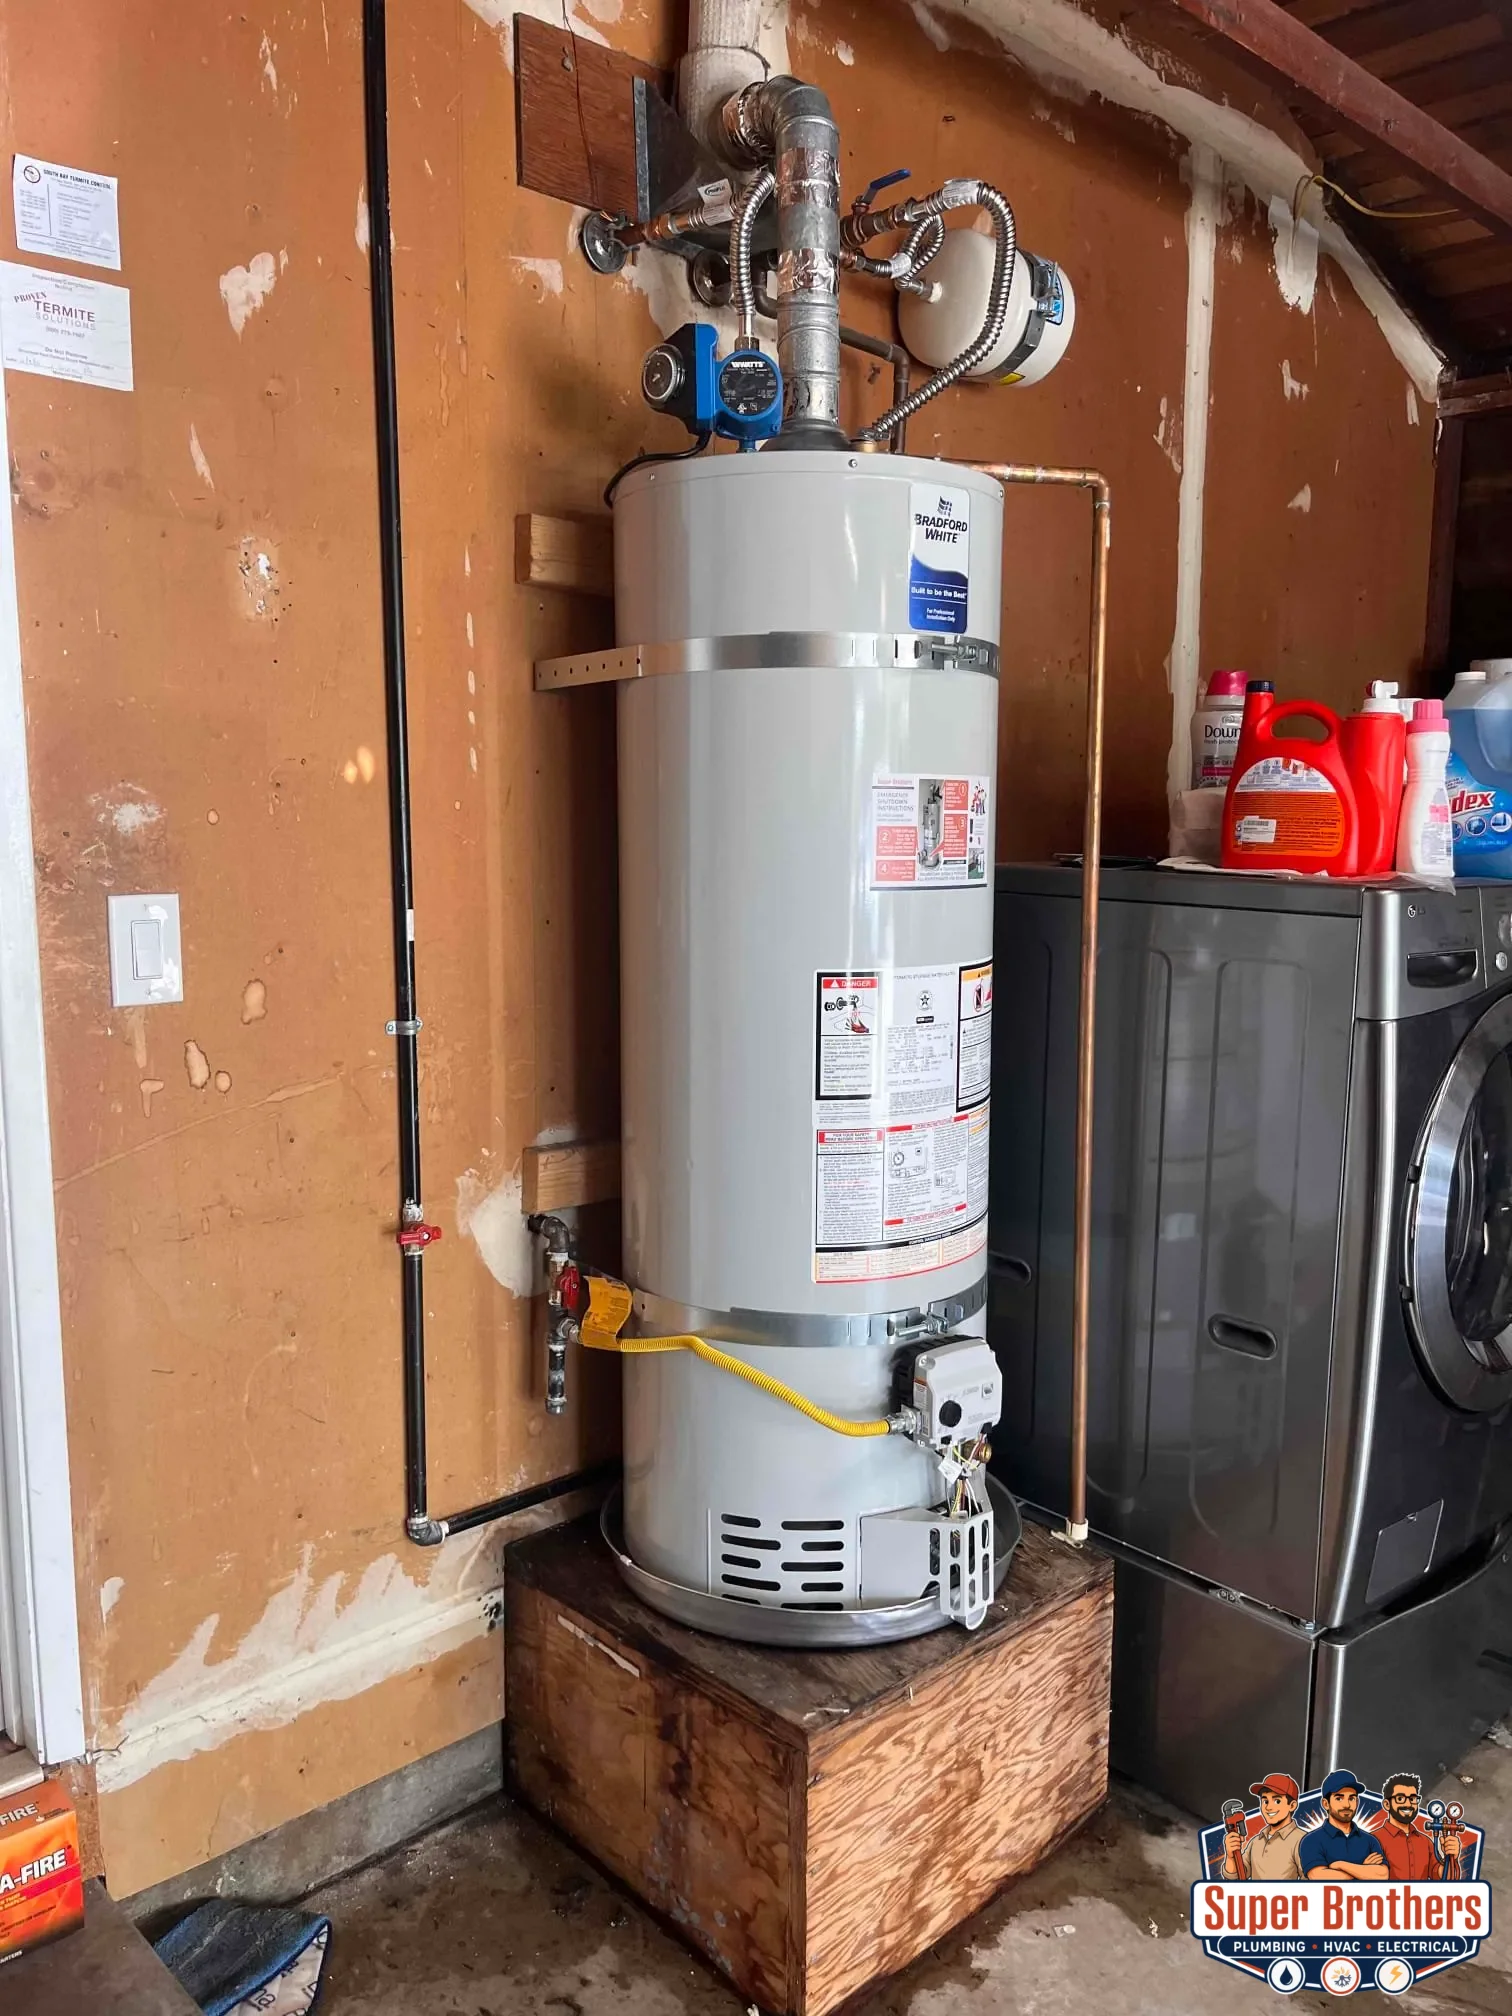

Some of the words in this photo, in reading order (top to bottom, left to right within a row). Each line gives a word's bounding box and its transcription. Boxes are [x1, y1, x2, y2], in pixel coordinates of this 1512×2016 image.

[14, 291, 47, 303] PROVEN
[34, 300, 96, 323] TERMITE
[35, 311, 97, 331] SOLUTIONS
[915, 513, 968, 532] BRADFORD
[925, 527, 958, 544] WHITE
[0, 1803, 38, 1826] FIRE
